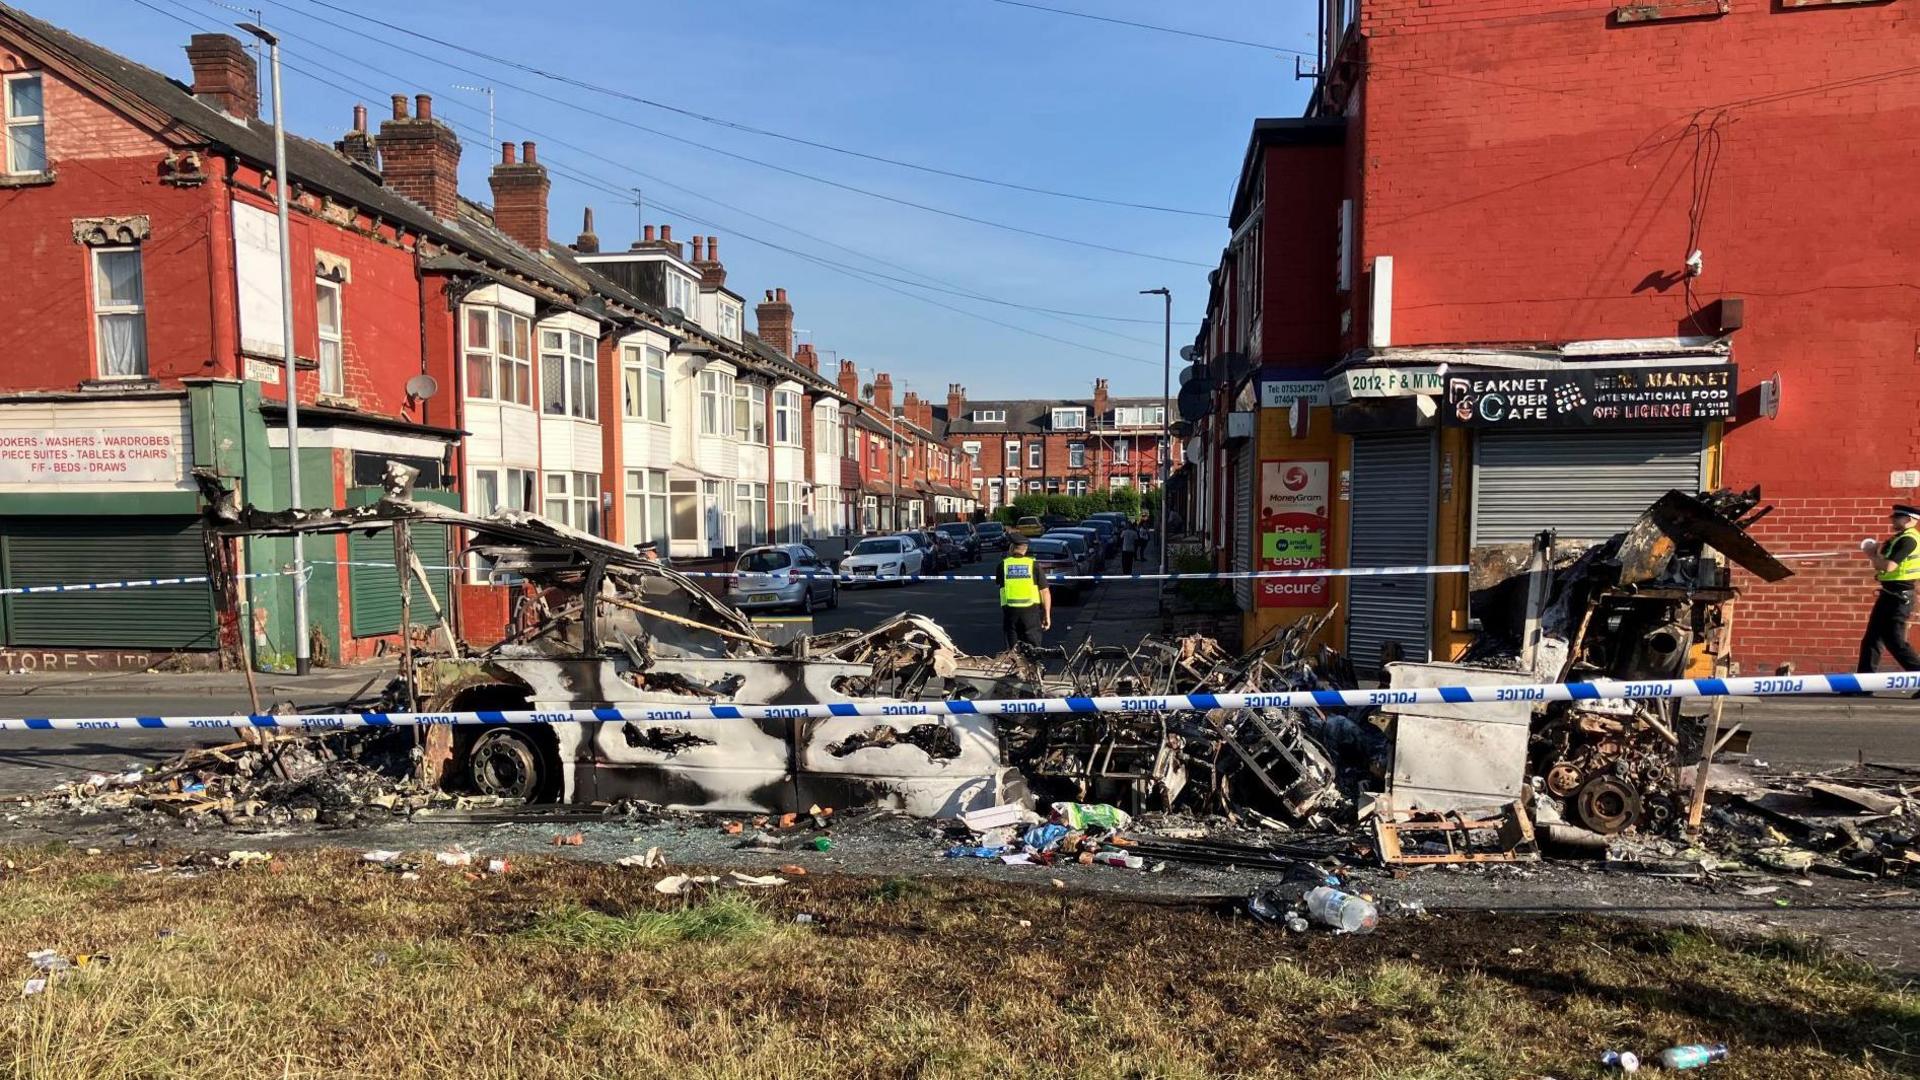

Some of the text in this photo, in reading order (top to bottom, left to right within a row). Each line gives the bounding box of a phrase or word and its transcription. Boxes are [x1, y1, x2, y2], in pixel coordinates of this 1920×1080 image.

[1389, 375, 1396, 389] F
[1401, 373, 1409, 388] &
[1414, 373, 1423, 388] M
[1691, 390, 1728, 400] FOOD
[45, 437, 95, 446] WASHERS
[104, 436, 170, 446] WARDROBES
[2, 450, 31, 460] PIECE
[33, 450, 68, 460] SUITES
[77, 450, 116, 459] TABLES
[119, 450, 125, 459] &
[128, 449, 168, 459] CHAIRS
[31, 463, 45, 472] F/F
[53, 463, 81, 472] BEDS
[89, 463, 127, 472] DRAWS
[1270, 494, 1322, 503] MoneyGram
[1265, 583, 1322, 594] secure
[1625, 685, 1672, 696] POLICE
[1754, 680, 1803, 693] POLICE
[1370, 693, 1417, 704] POLICE
[1497, 688, 1544, 700] POLICE
[1121, 700, 1166, 710] POLICE
[1244, 696, 1290, 707] POLICE
[882, 706, 926, 715] POLICE
[1001, 702, 1045, 712] POLICE
[765, 709, 809, 718] POLICE
